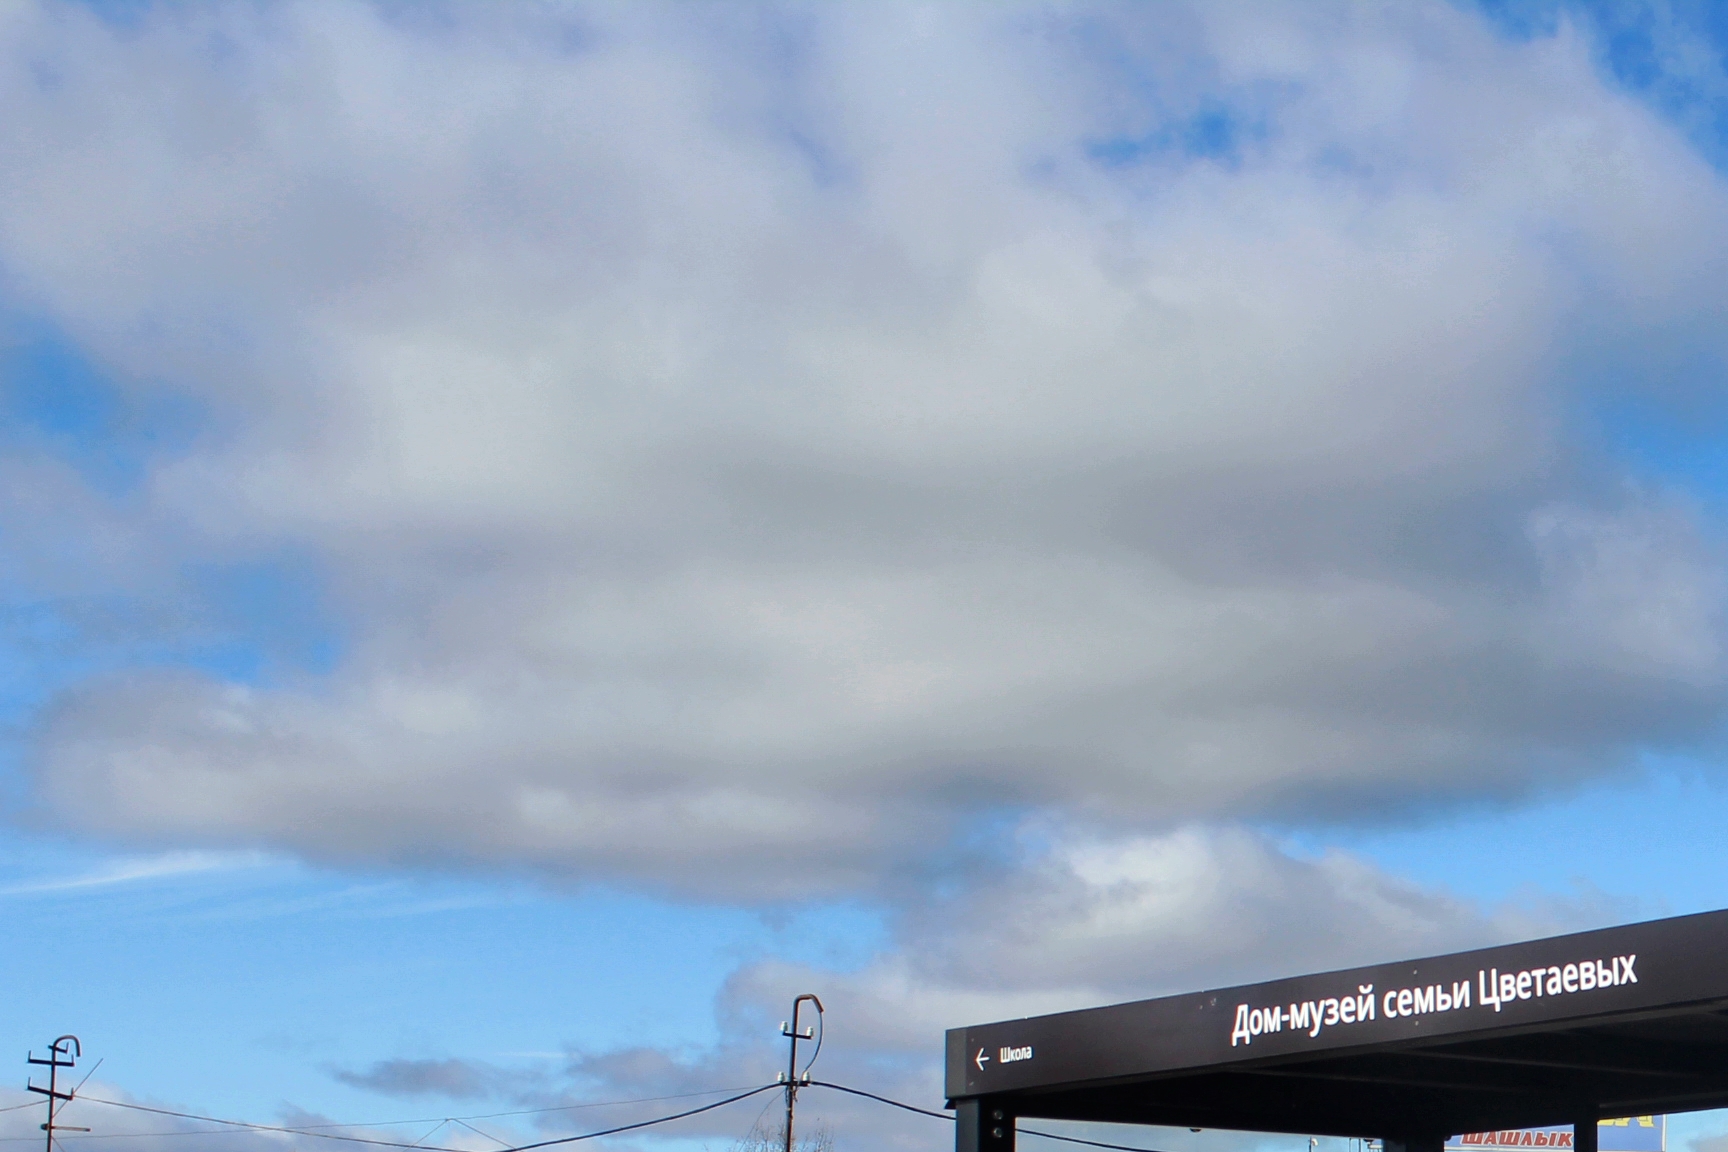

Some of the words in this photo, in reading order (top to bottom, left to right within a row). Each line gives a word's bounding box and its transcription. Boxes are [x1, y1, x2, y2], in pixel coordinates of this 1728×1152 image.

[1231, 984, 1376, 1046] Дом-музей
[1383, 980, 1471, 1019] семьи
[1478, 954, 1638, 1013] Цветаевых
[1000, 1046, 1032, 1063] Школа
[1461, 1131, 1573, 1147] ШАШЛЫК
